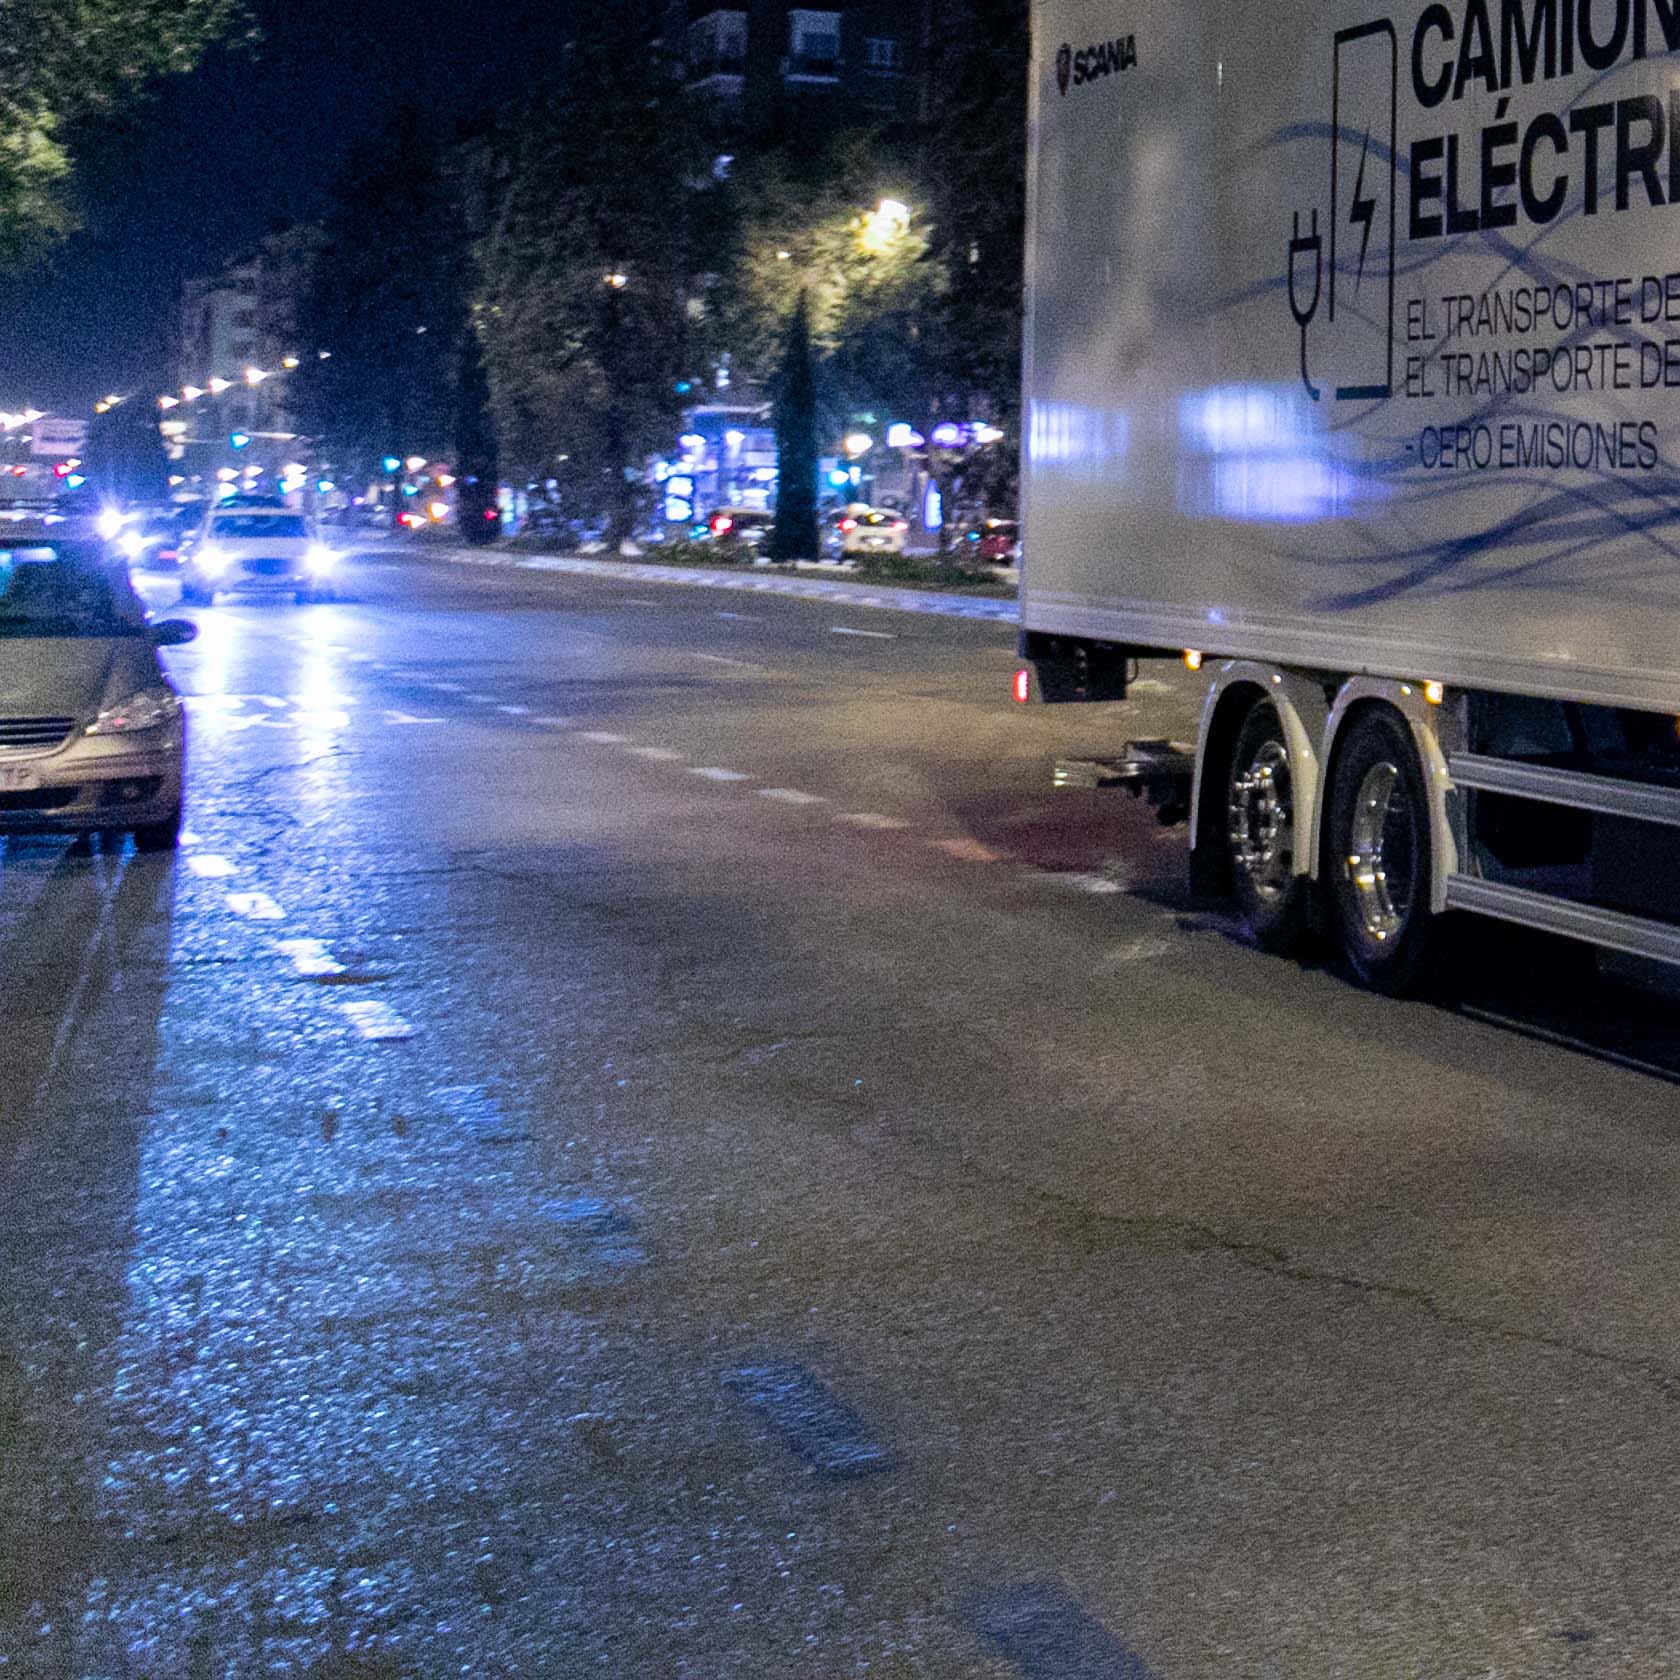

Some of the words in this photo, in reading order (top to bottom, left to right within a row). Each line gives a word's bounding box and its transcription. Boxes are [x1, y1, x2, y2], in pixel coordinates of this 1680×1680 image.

[1074, 34, 1138, 87] SCANIA
[1406, 297, 1436, 342] EL
[1440, 276, 1634, 338] TRANSPORTE
[1405, 355, 1435, 399] EL
[1440, 342, 1633, 396] TRANSPORTE
[1420, 422, 1494, 470] CERO
[1500, 419, 1660, 471] EMISIONES
